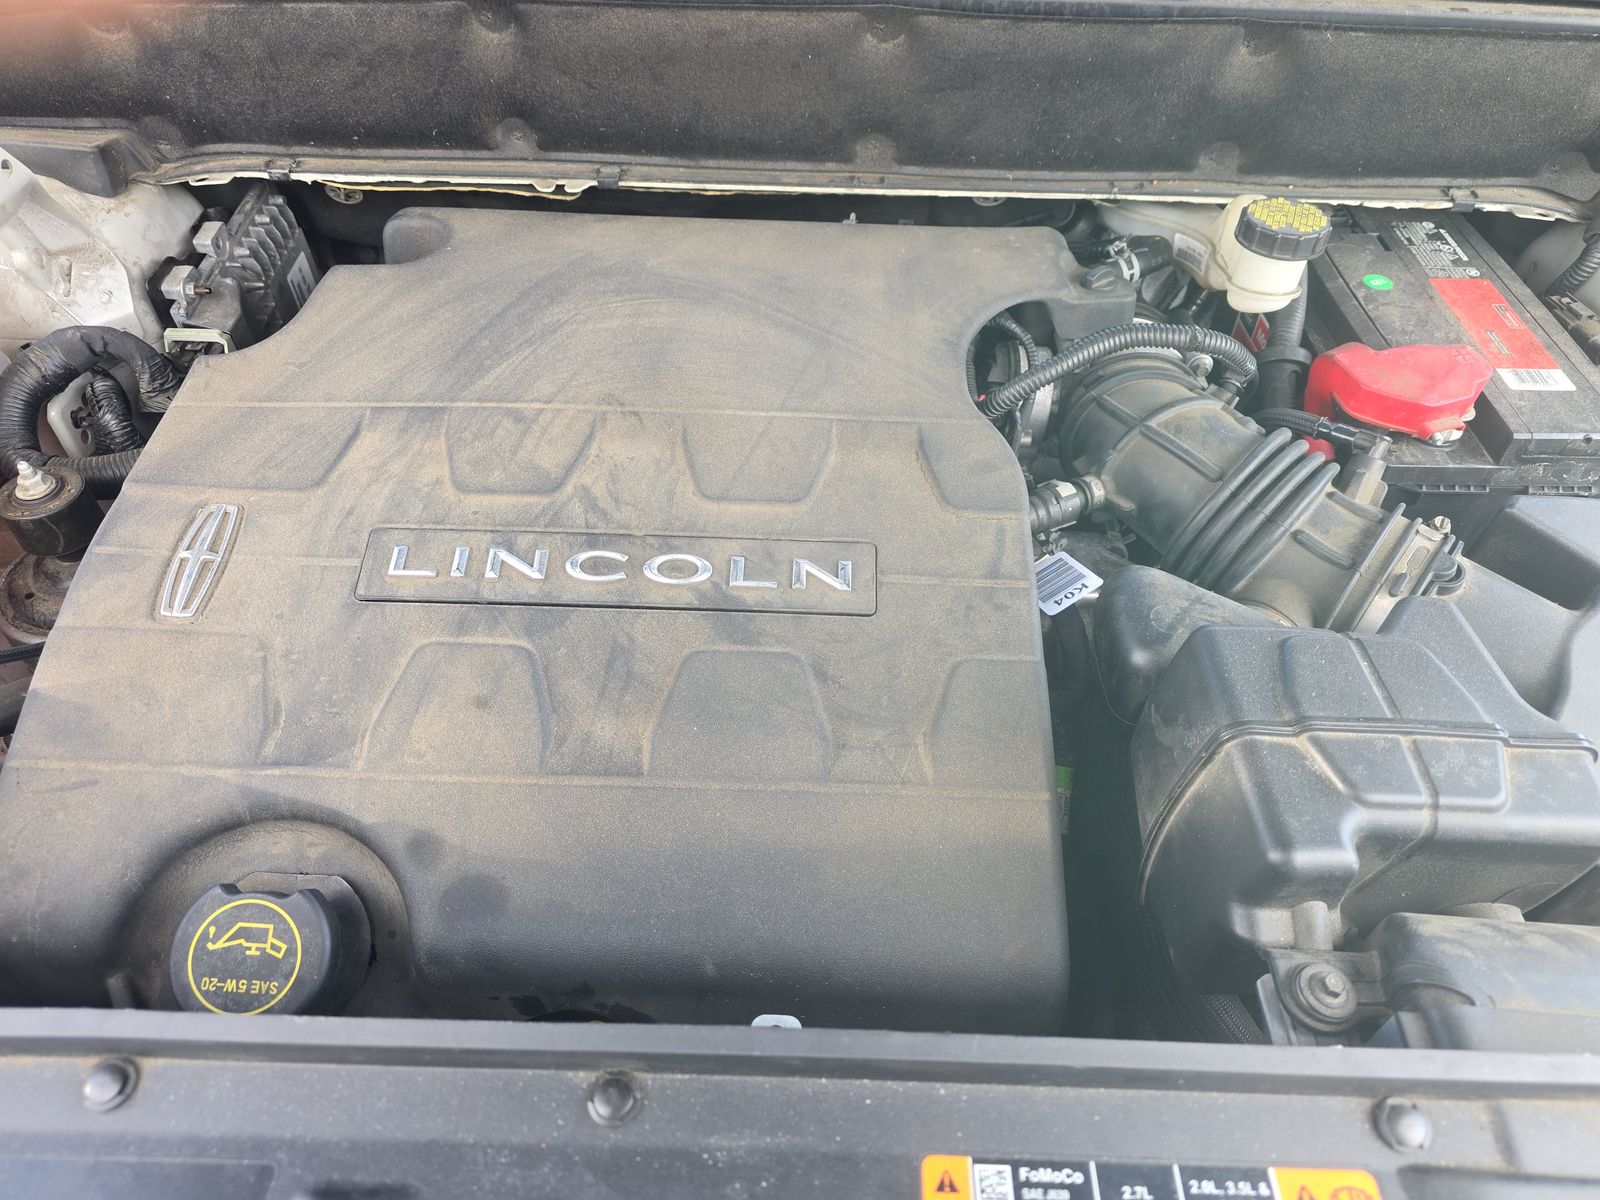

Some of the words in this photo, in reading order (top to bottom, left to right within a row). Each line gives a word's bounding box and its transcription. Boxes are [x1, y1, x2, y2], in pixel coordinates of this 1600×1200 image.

[388, 544, 853, 592] LINCOLN
[1053, 583, 1089, 607] K04
[200, 976, 248, 994] 5W-20
[250, 979, 279, 995] SAE
